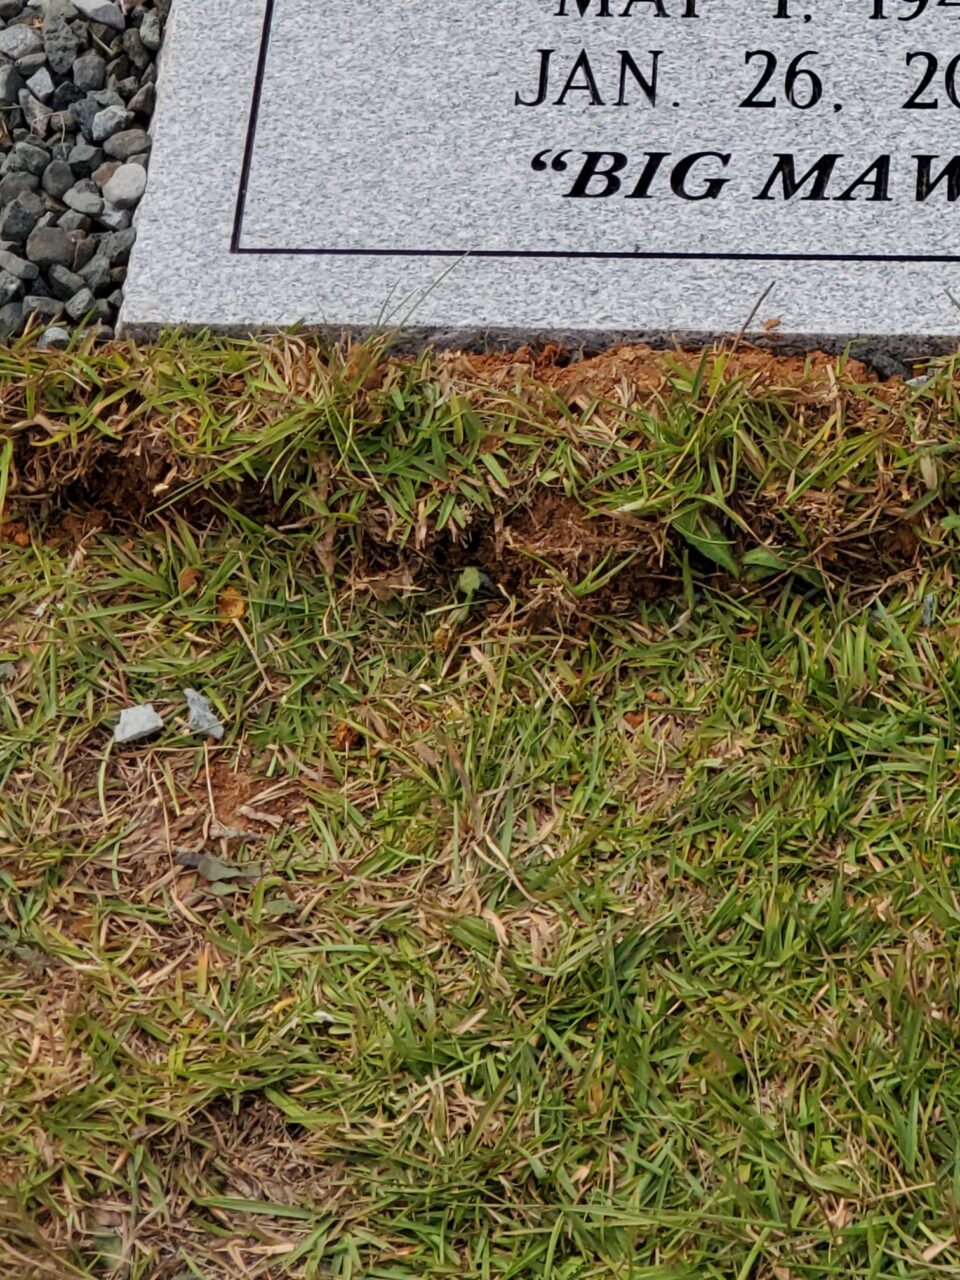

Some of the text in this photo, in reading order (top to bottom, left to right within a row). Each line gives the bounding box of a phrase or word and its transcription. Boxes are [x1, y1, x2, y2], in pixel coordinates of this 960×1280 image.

[514, 48, 680, 108] JAN.
[738, 49, 843, 113] 26,
[530, 148, 732, 202] “BIG
